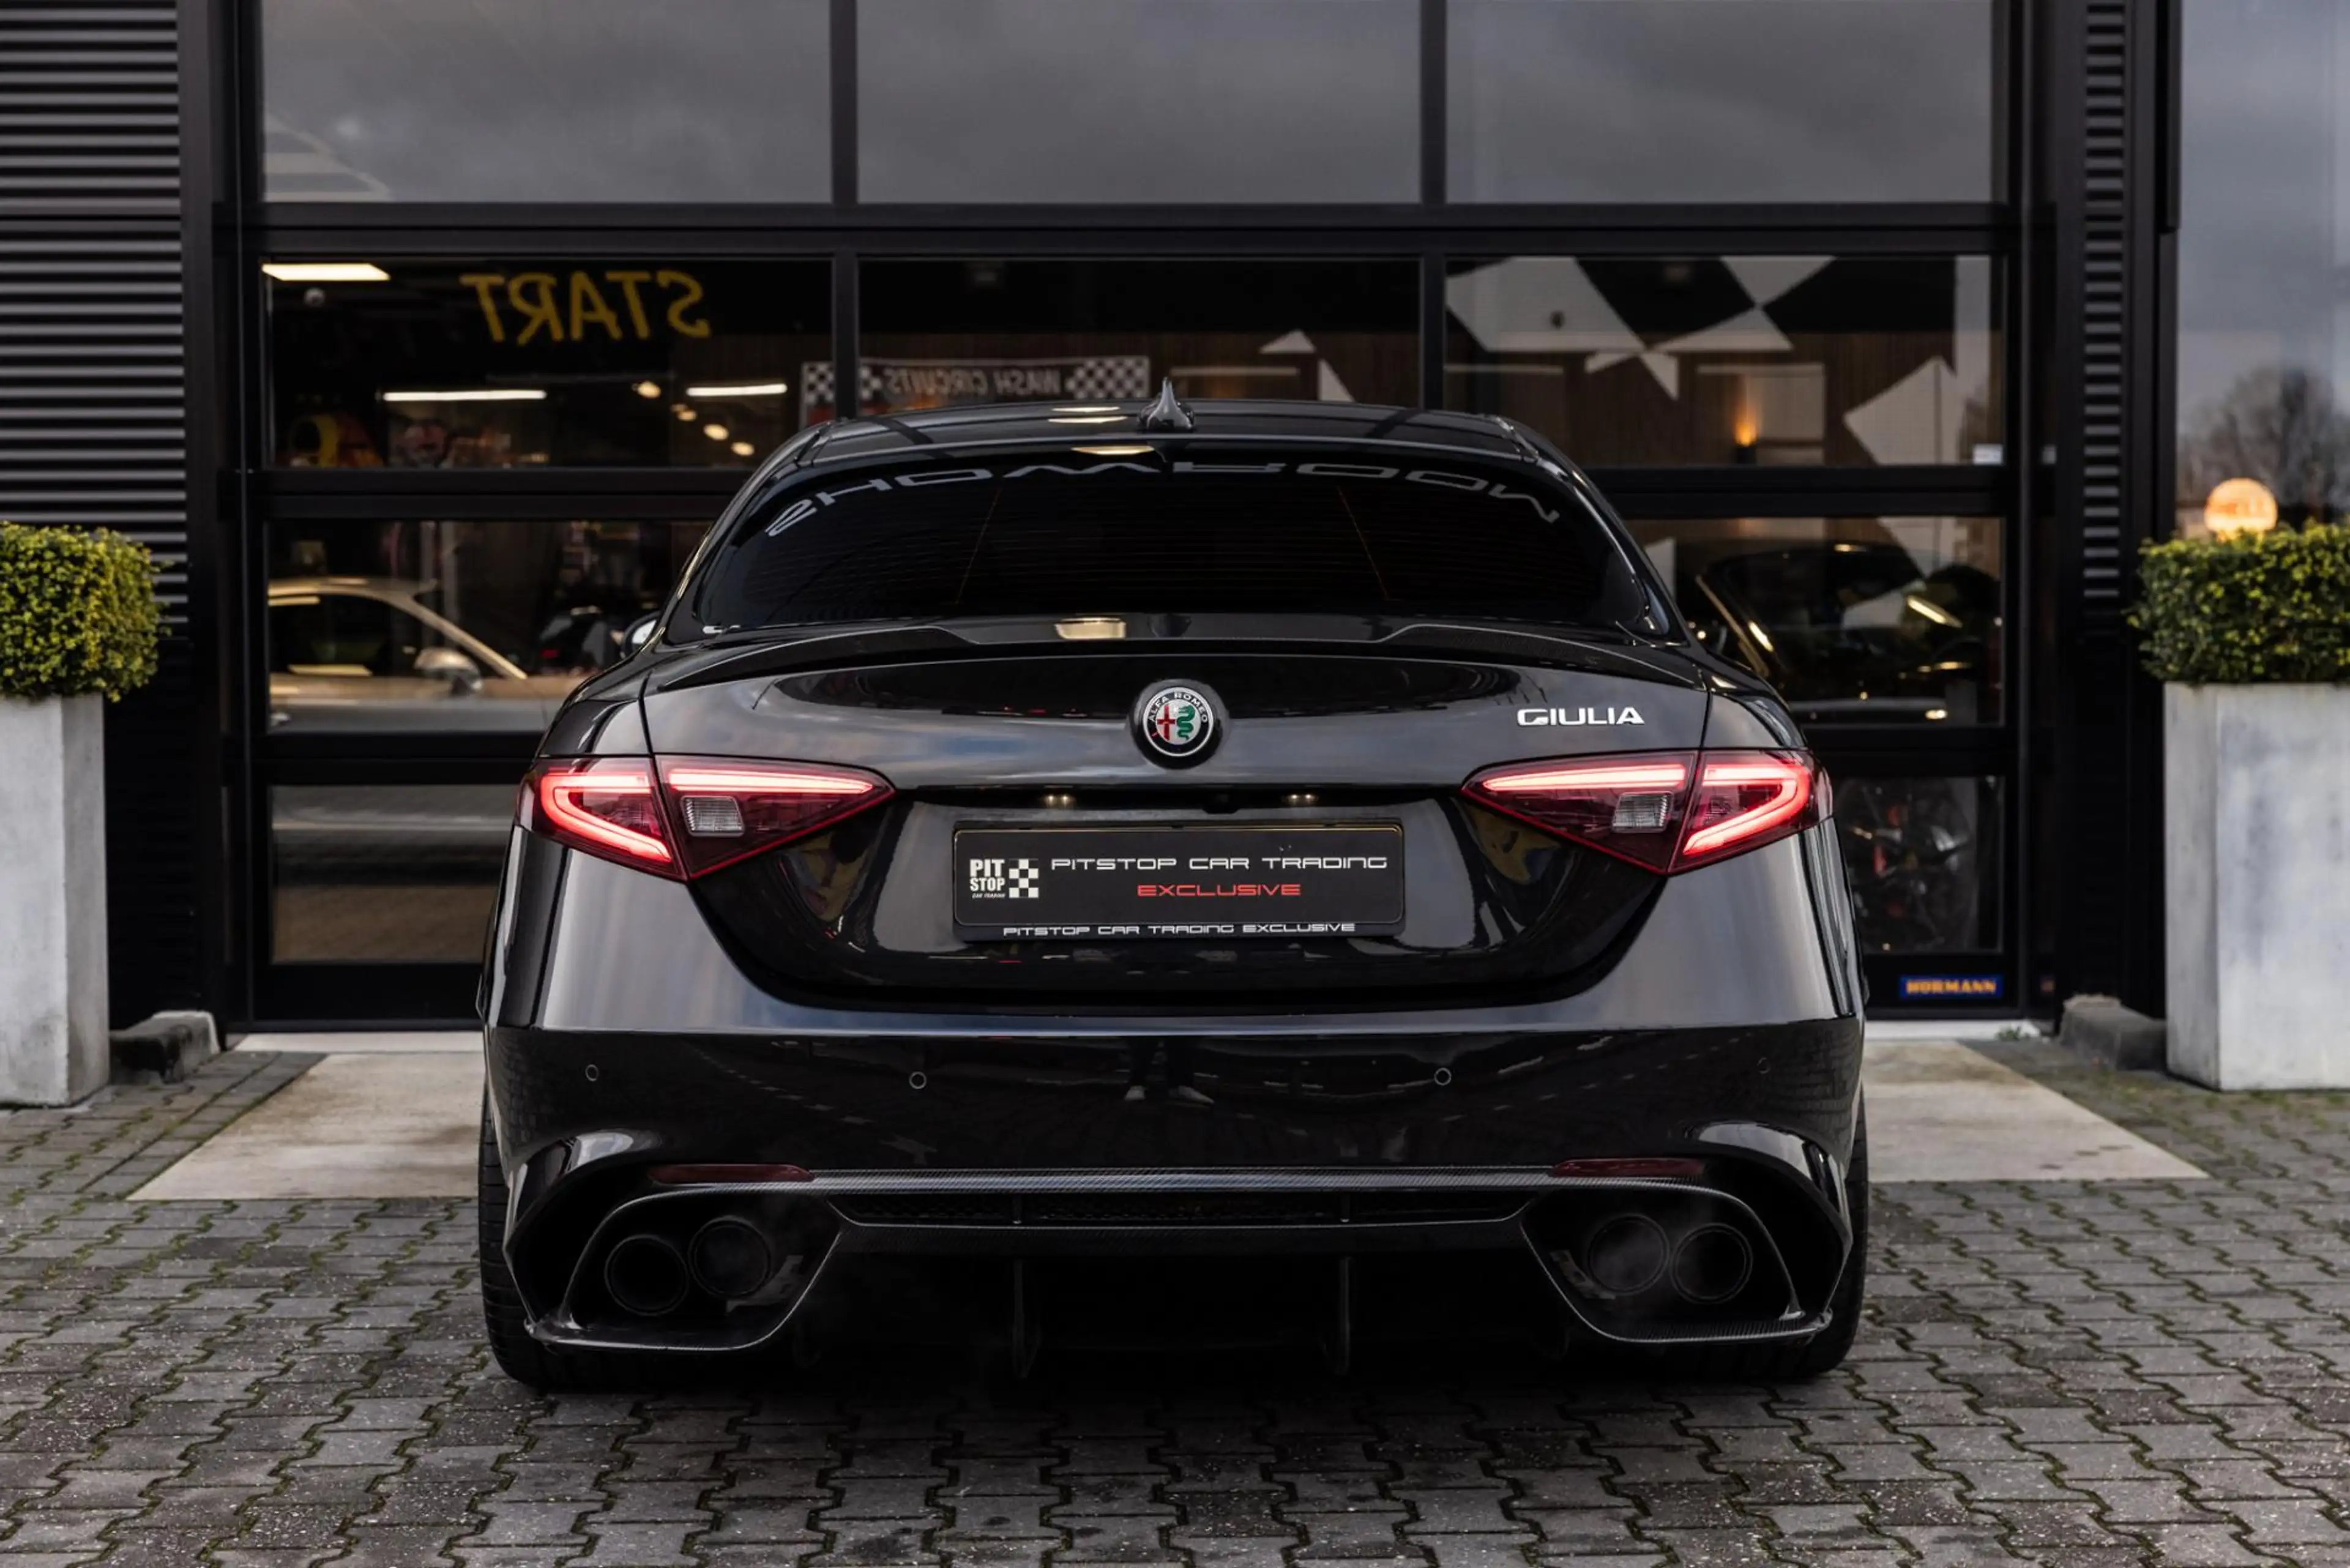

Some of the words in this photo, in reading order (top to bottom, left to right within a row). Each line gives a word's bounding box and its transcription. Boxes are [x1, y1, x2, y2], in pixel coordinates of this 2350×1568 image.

[1148, 696, 1170, 723] ALFA
[1174, 692, 1209, 723] ROMEO
[1517, 707, 1646, 726] GIULIA
[969, 859, 1005, 877] PIT
[1051, 858, 1177, 870] PITSTOP
[1189, 857, 1250, 870] CAR
[1261, 857, 1387, 869] TRADING
[969, 877, 1005, 892] STOP
[1137, 884, 1301, 897] EXCLUSIVE
[1003, 926, 1091, 936] PITSTOP
[1097, 925, 1140, 935] CAR
[1147, 924, 1234, 934] TRADING
[1242, 922, 1355, 933] EXCLUSIVE
